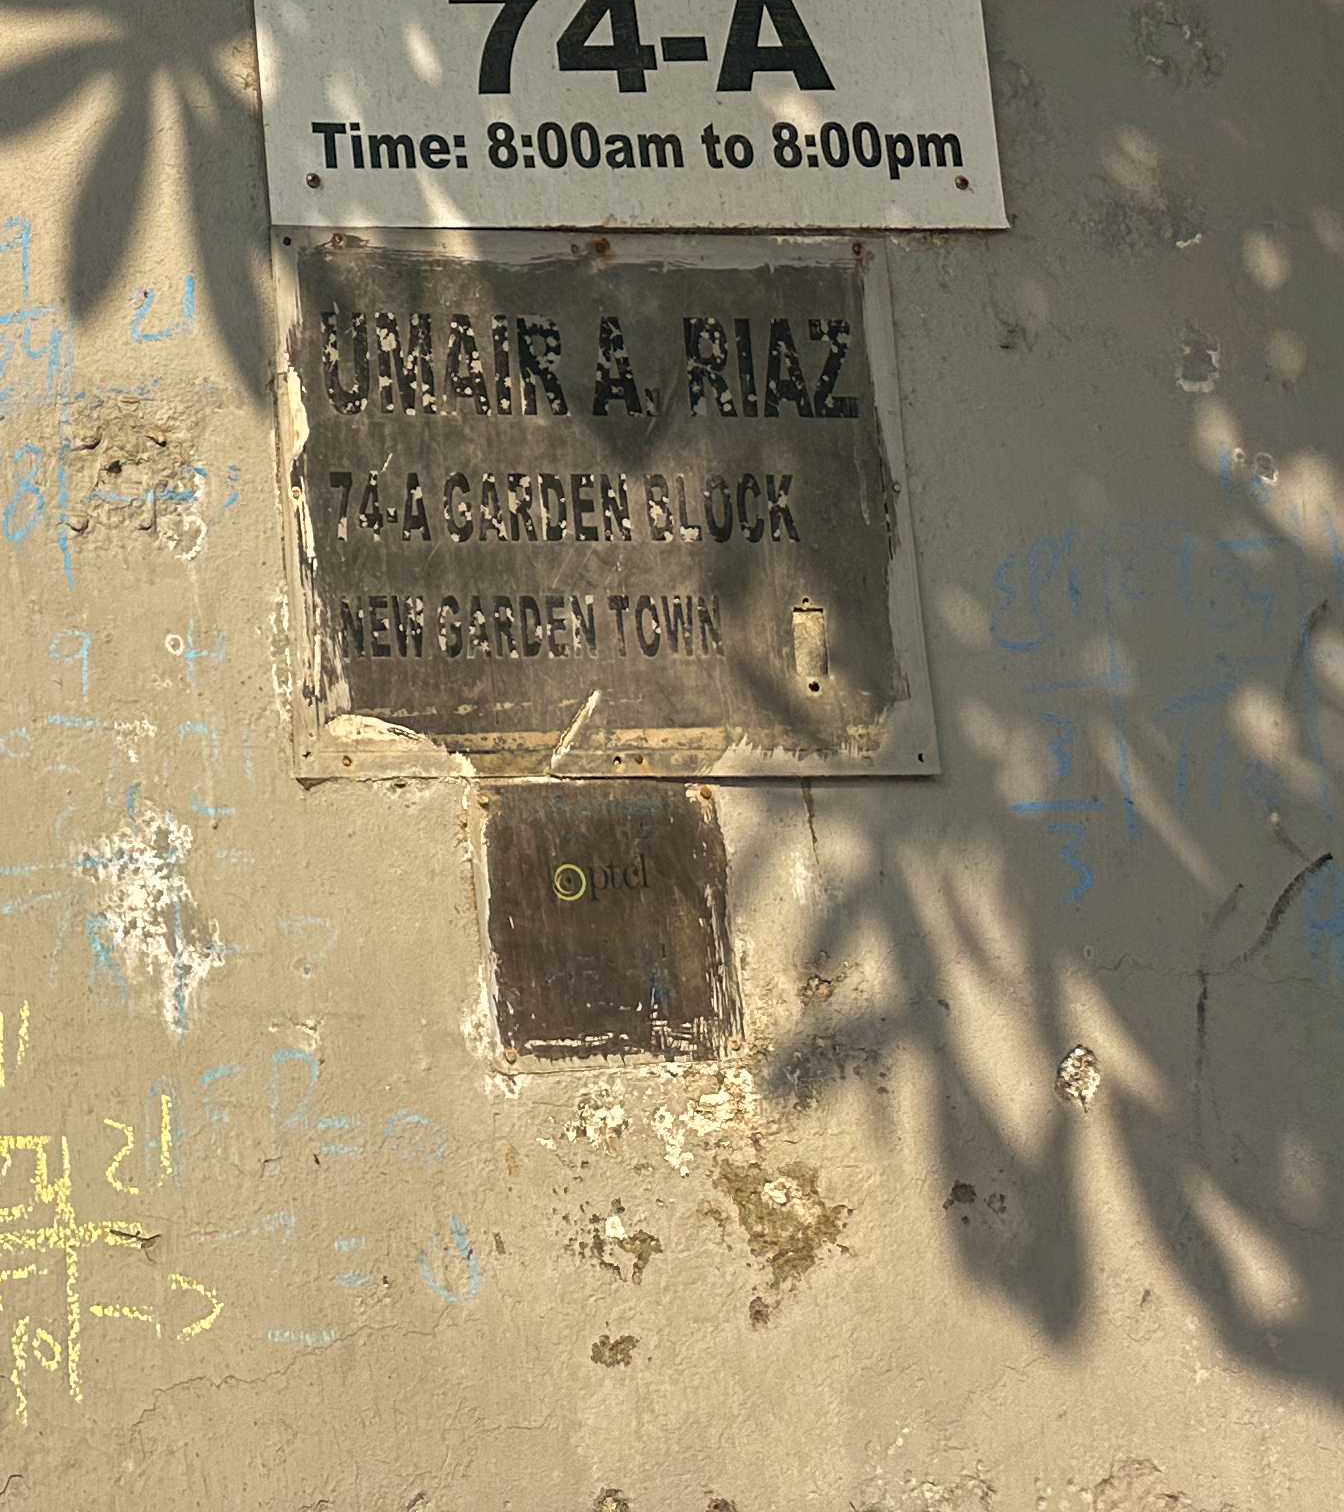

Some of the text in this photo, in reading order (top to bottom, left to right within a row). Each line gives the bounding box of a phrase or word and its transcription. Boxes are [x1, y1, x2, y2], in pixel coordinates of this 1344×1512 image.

[311, 121, 965, 180] Time: 8:00am to 8:00pm
[319, 310, 570, 418] UMAIR
[682, 316, 861, 419] RIAZ
[330, 470, 801, 543] 74-A GARDEN BLOCK
[339, 594, 725, 660] NEW GARDEN TOWN
[588, 852, 649, 902] ptcl
